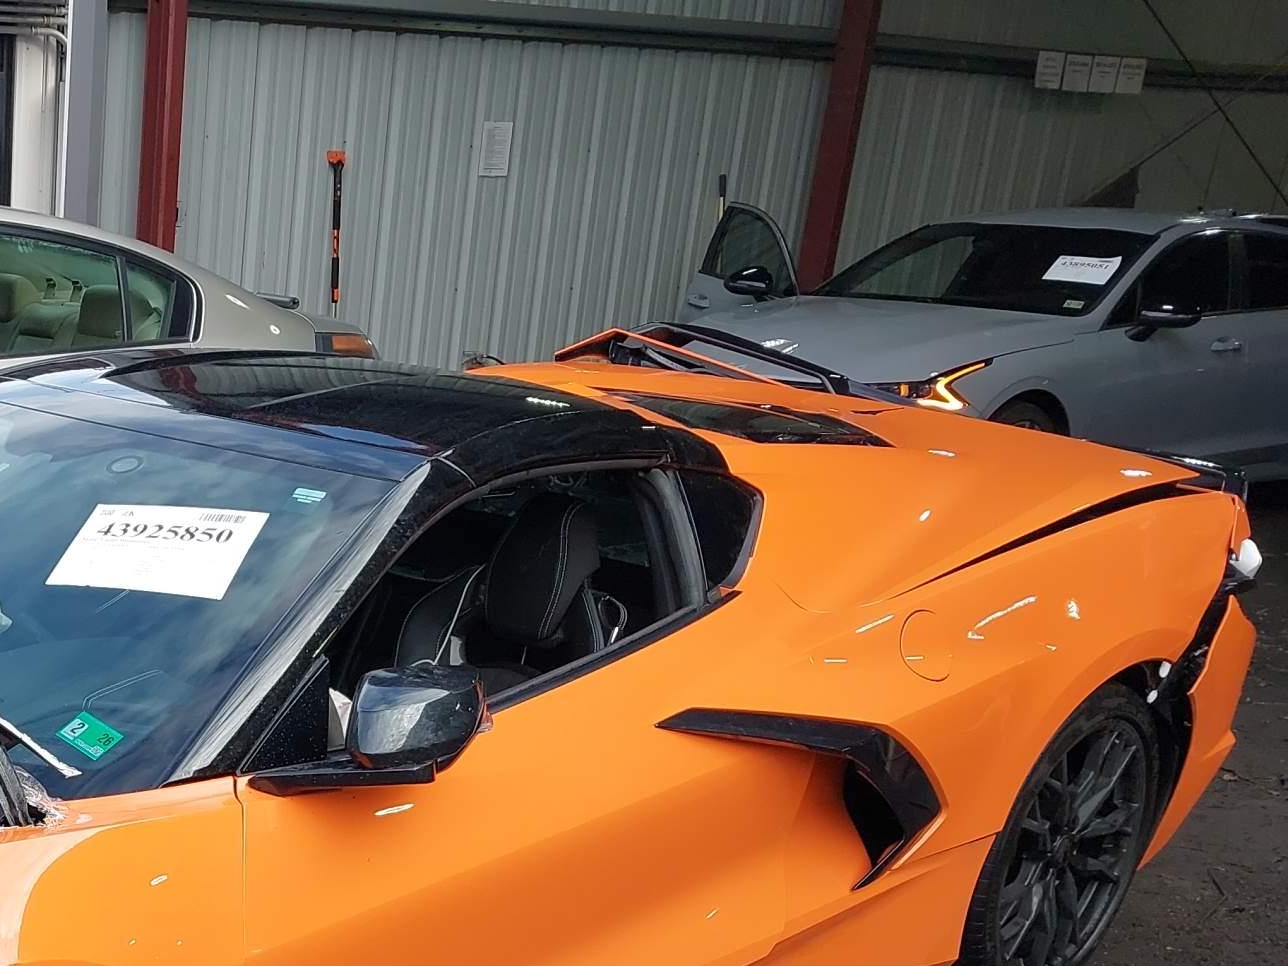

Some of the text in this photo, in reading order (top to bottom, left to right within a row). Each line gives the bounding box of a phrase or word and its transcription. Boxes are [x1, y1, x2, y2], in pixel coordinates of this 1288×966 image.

[97, 521, 234, 544] 43925850
[69, 722, 86, 735] 2
[97, 733, 115, 746] 26
